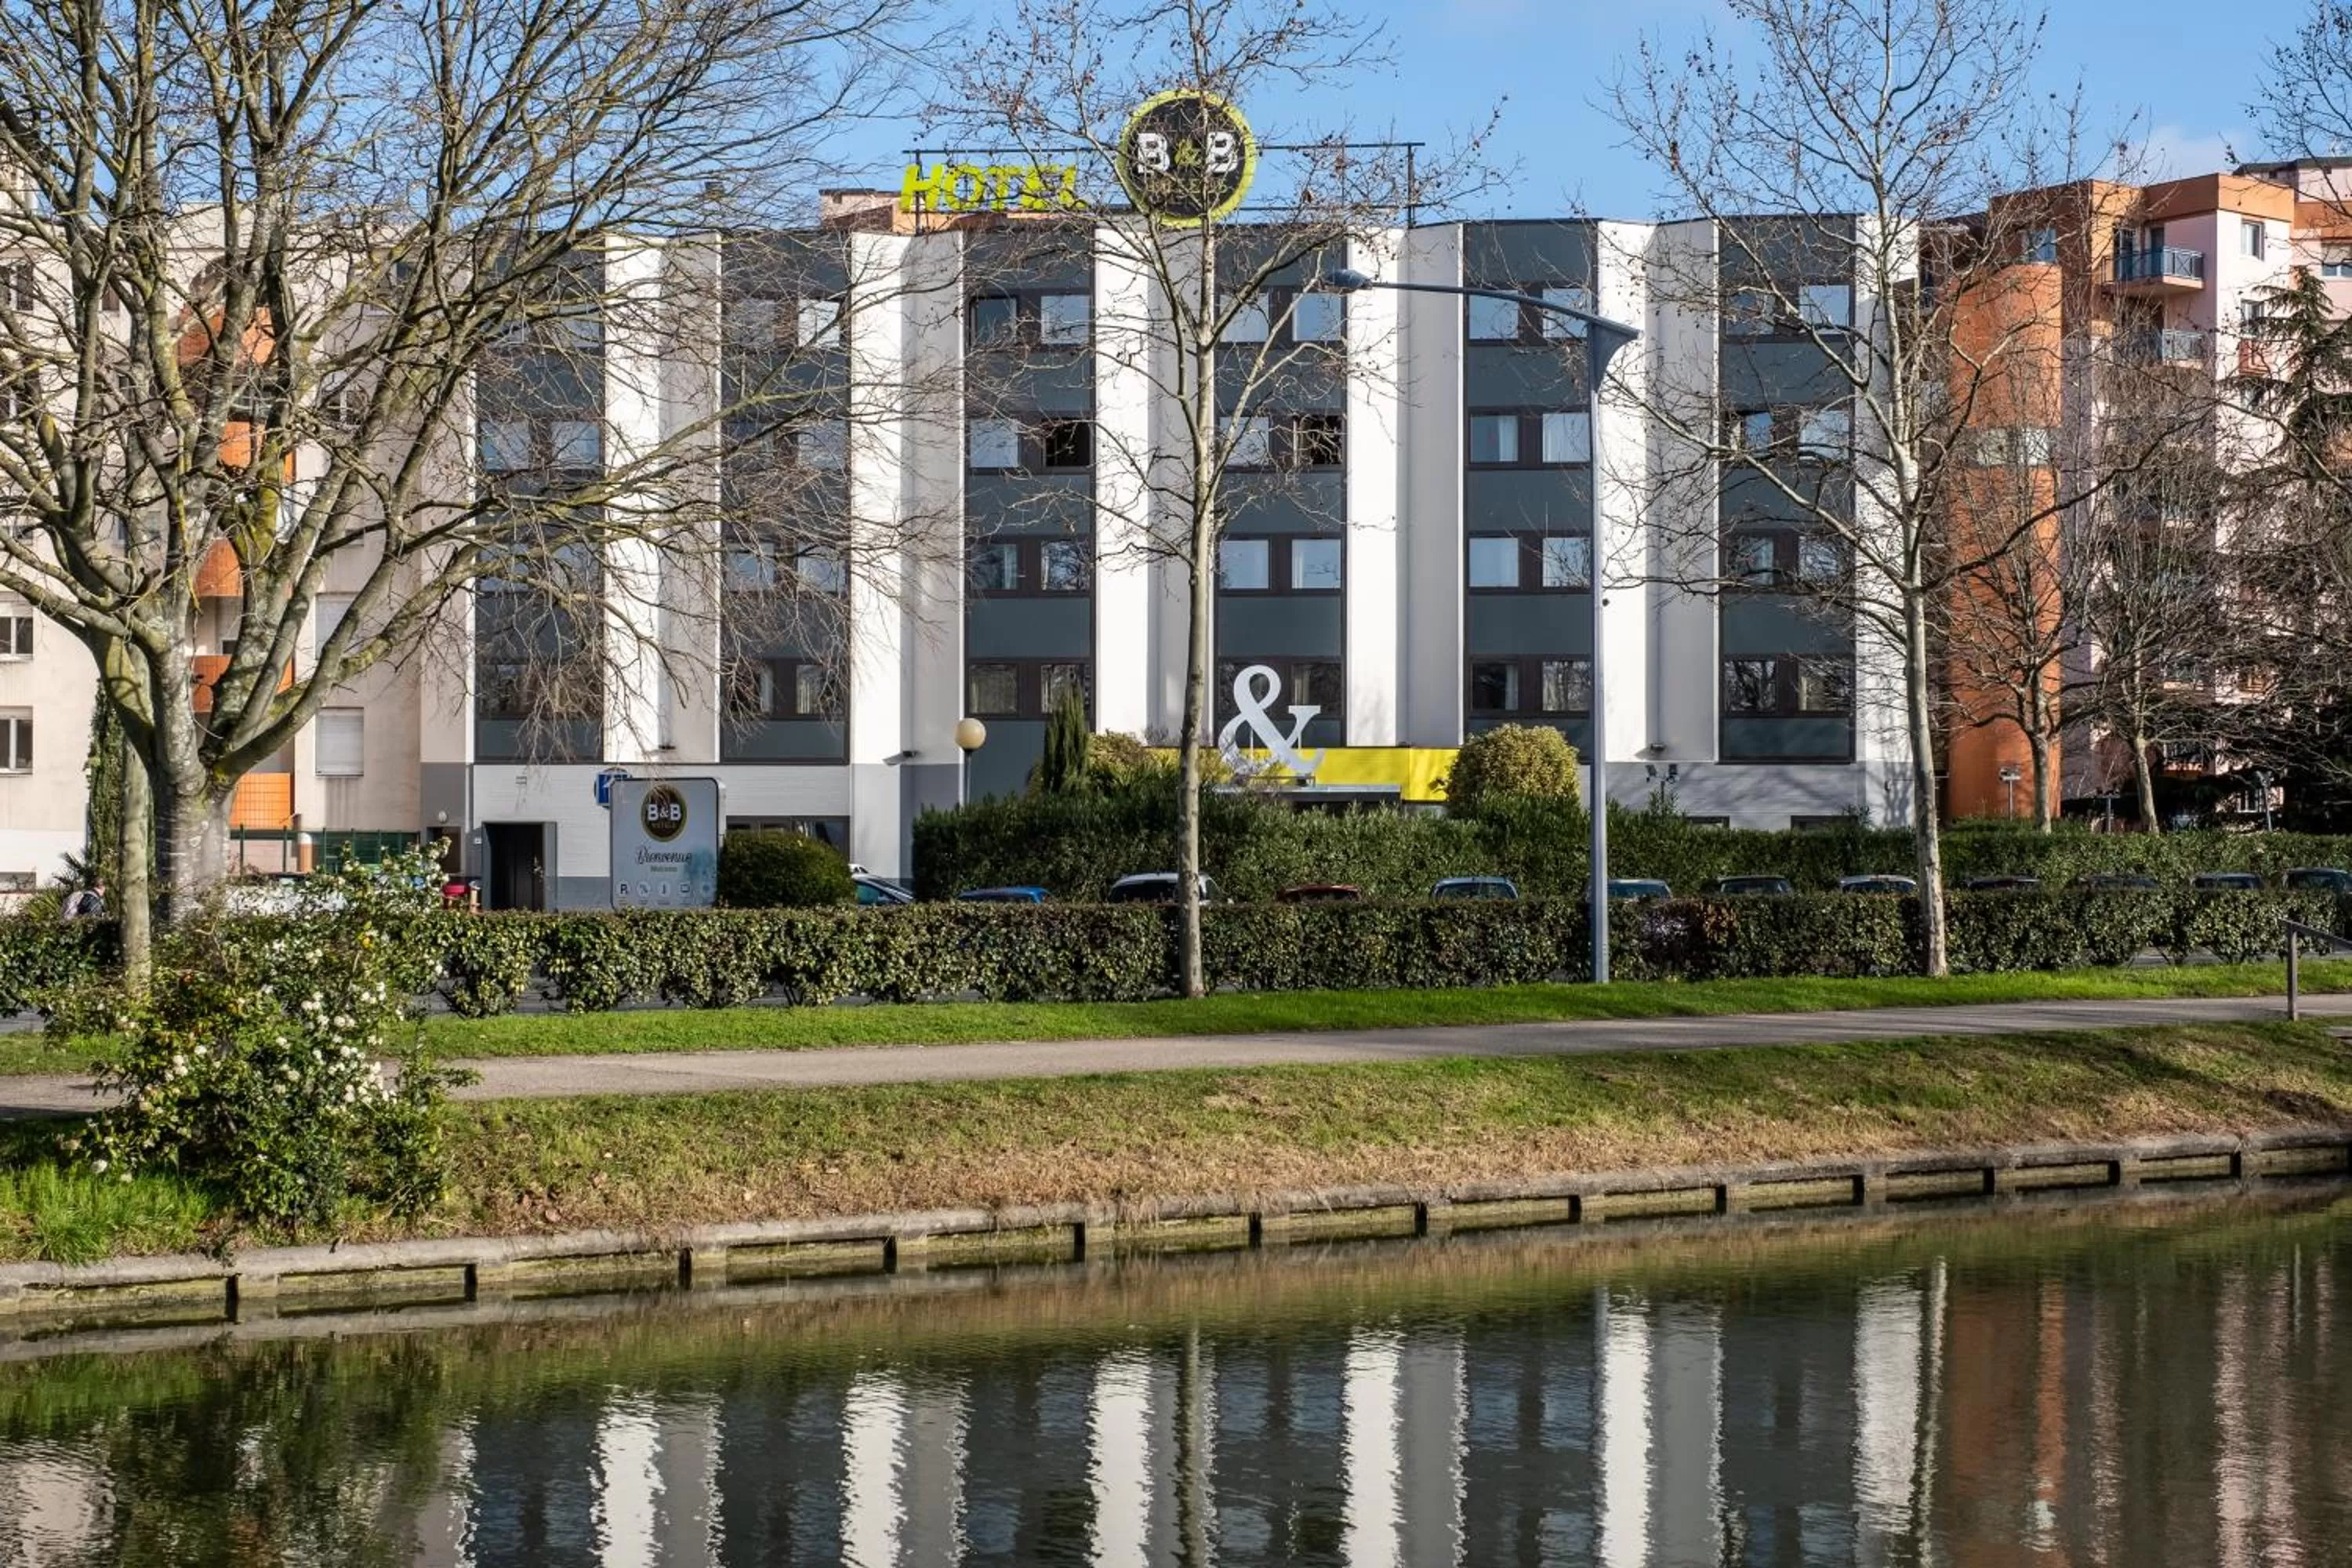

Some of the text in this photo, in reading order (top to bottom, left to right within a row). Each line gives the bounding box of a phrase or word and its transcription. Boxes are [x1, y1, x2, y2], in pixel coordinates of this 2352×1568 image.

[1137, 131, 1239, 173] B&B
[901, 163, 1087, 211] HOTEL
[1218, 664, 1325, 775] &
[648, 804, 681, 821] B&B
